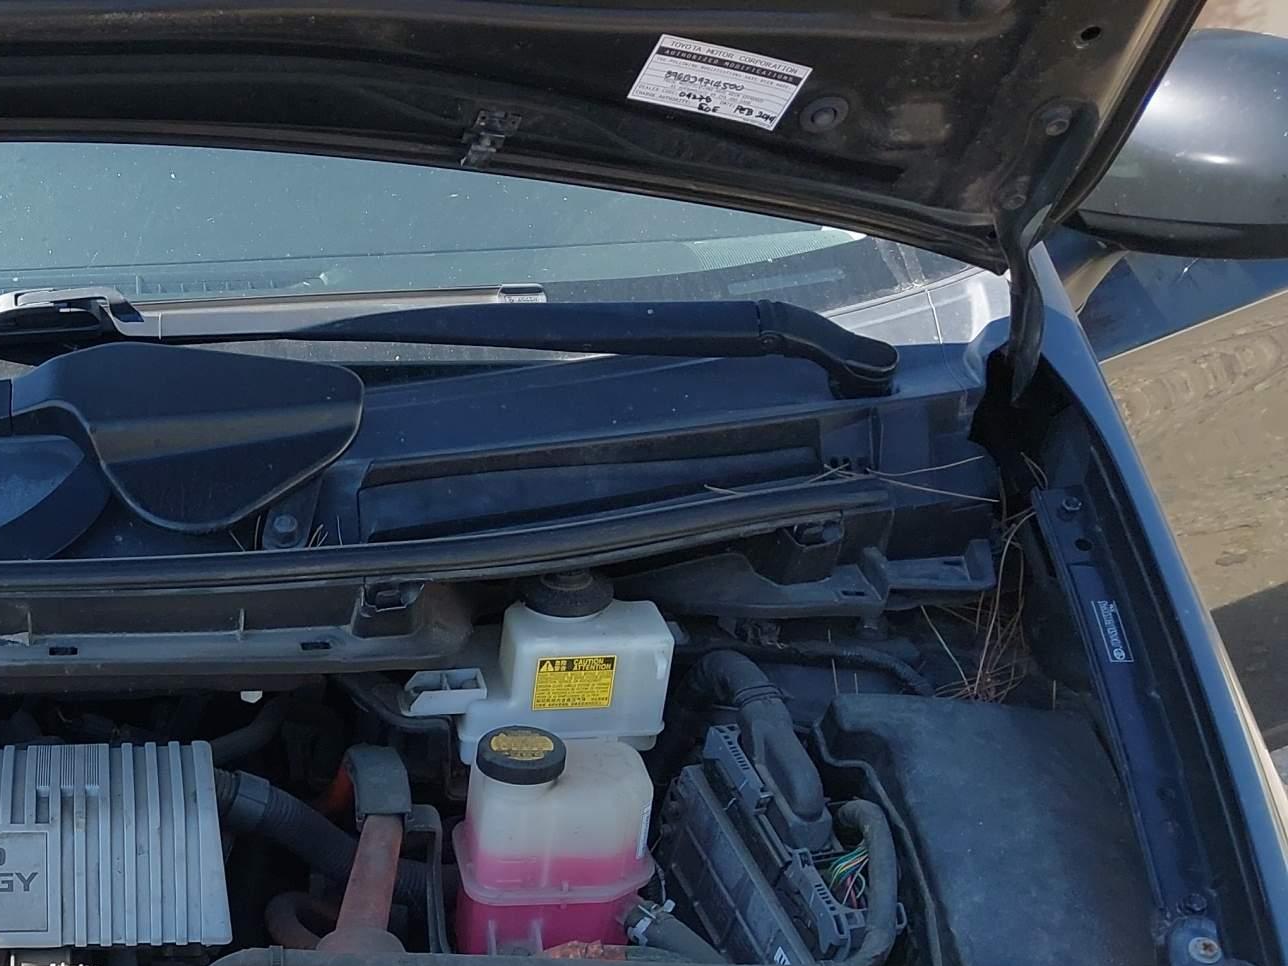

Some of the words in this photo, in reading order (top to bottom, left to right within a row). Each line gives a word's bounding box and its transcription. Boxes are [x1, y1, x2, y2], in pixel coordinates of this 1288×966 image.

[664, 49, 720, 65] AUTHORIZED
[724, 61, 794, 81] MODIFICATIONS
[671, 40, 702, 53] TOYOTA
[706, 48, 734, 59] MOTOR
[739, 55, 799, 75] CORPORATION
[572, 663, 612, 671] ATTENTION
